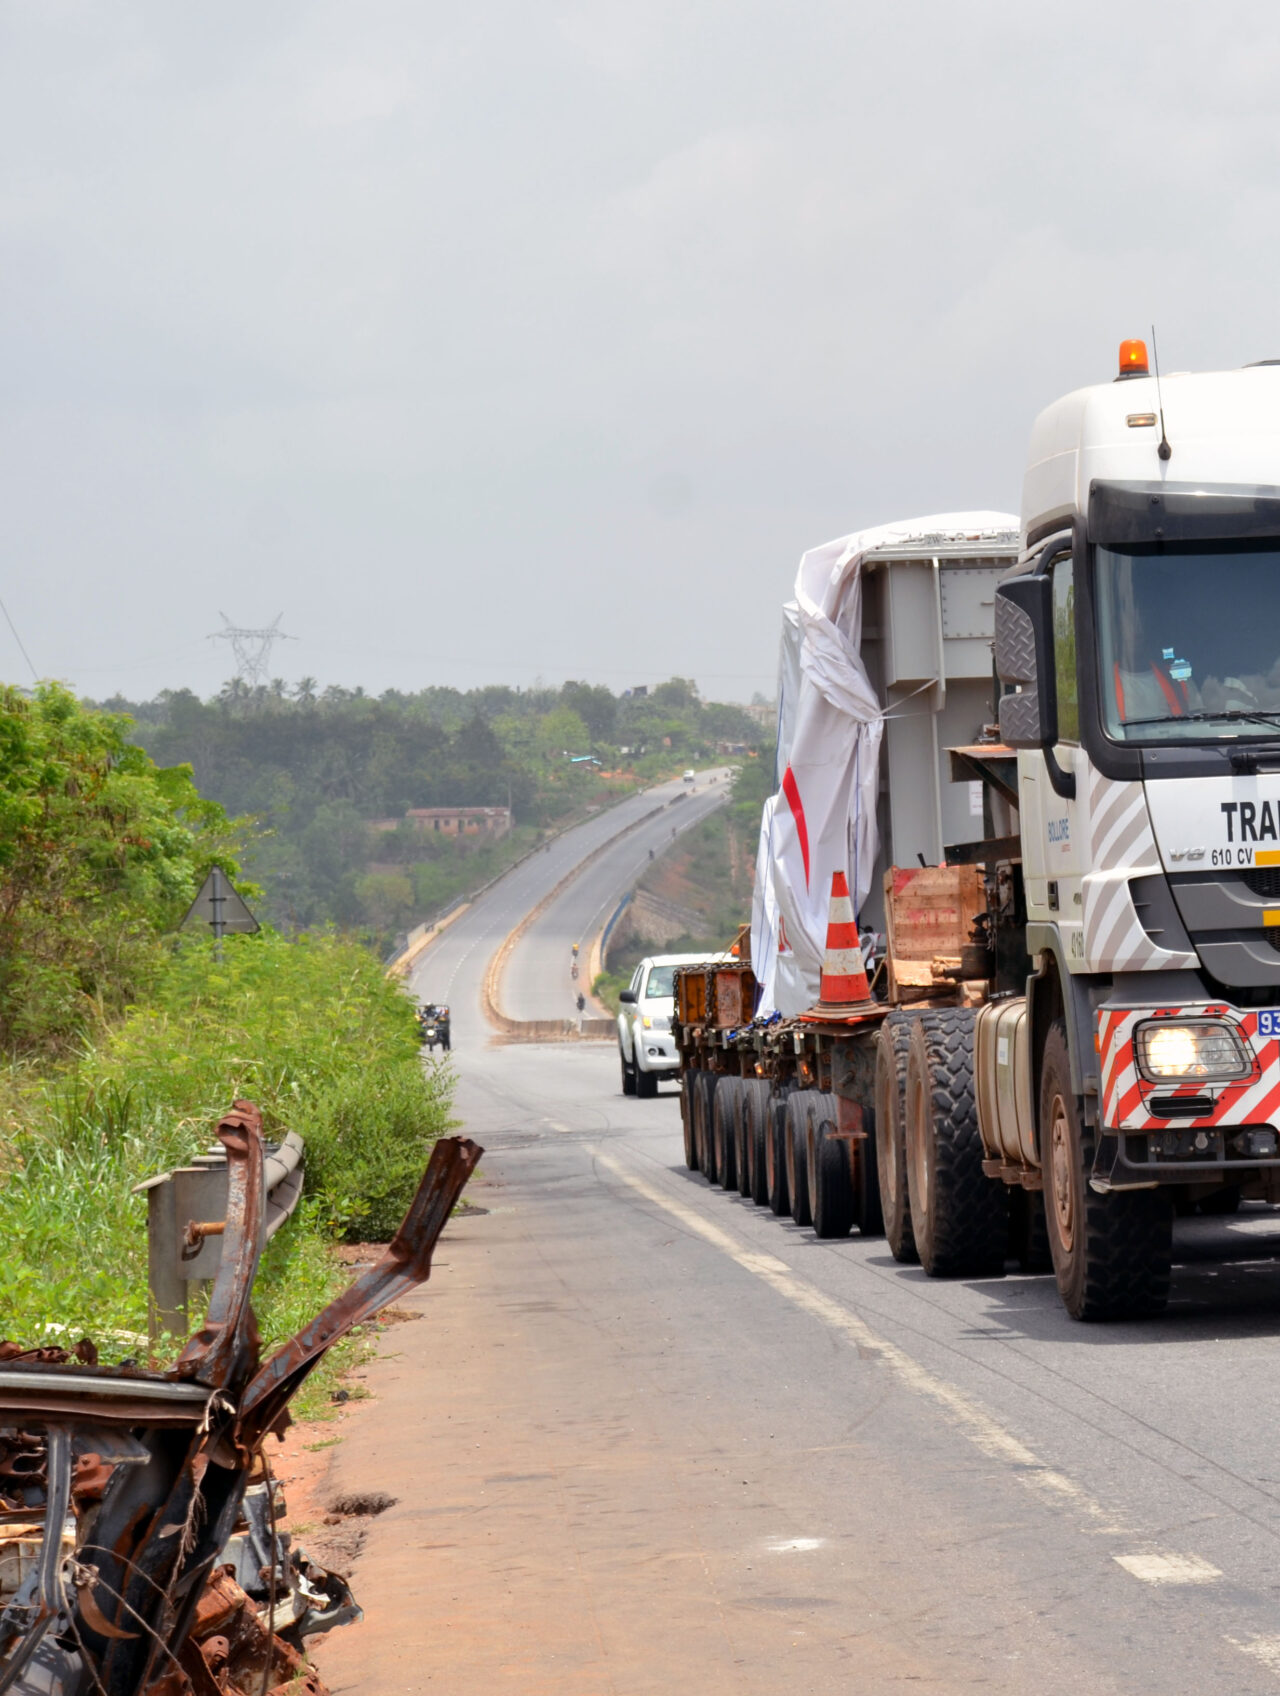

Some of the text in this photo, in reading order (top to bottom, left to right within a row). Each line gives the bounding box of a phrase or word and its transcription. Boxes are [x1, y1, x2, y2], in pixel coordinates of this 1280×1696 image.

[1169, 845, 1206, 862] V8
[1211, 847, 1253, 866] 610 CV
